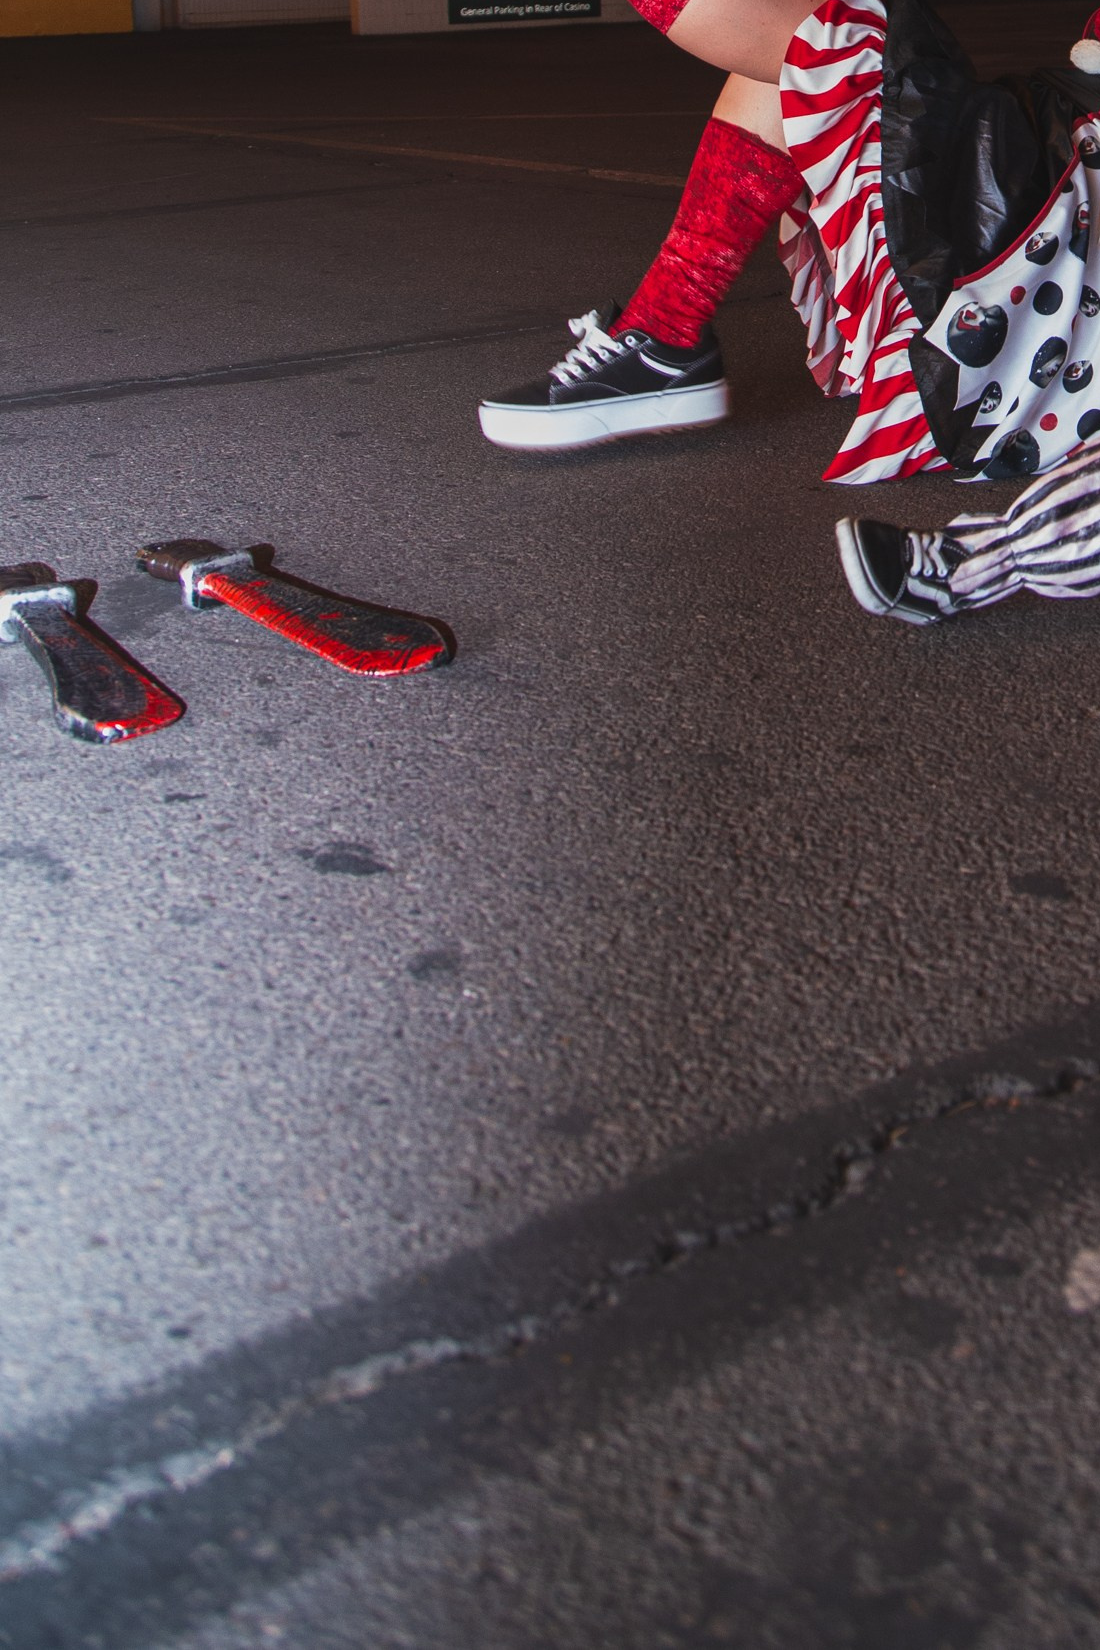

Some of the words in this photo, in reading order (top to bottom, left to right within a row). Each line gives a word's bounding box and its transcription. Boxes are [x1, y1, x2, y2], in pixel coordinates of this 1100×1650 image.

[460, 6, 493, 16] General
[494, 5, 525, 16] Parking
[525, 5, 533, 13] in
[535, 4, 551, 12] Rear
[554, 3, 563, 12] of
[564, 2, 591, 12] Casino
